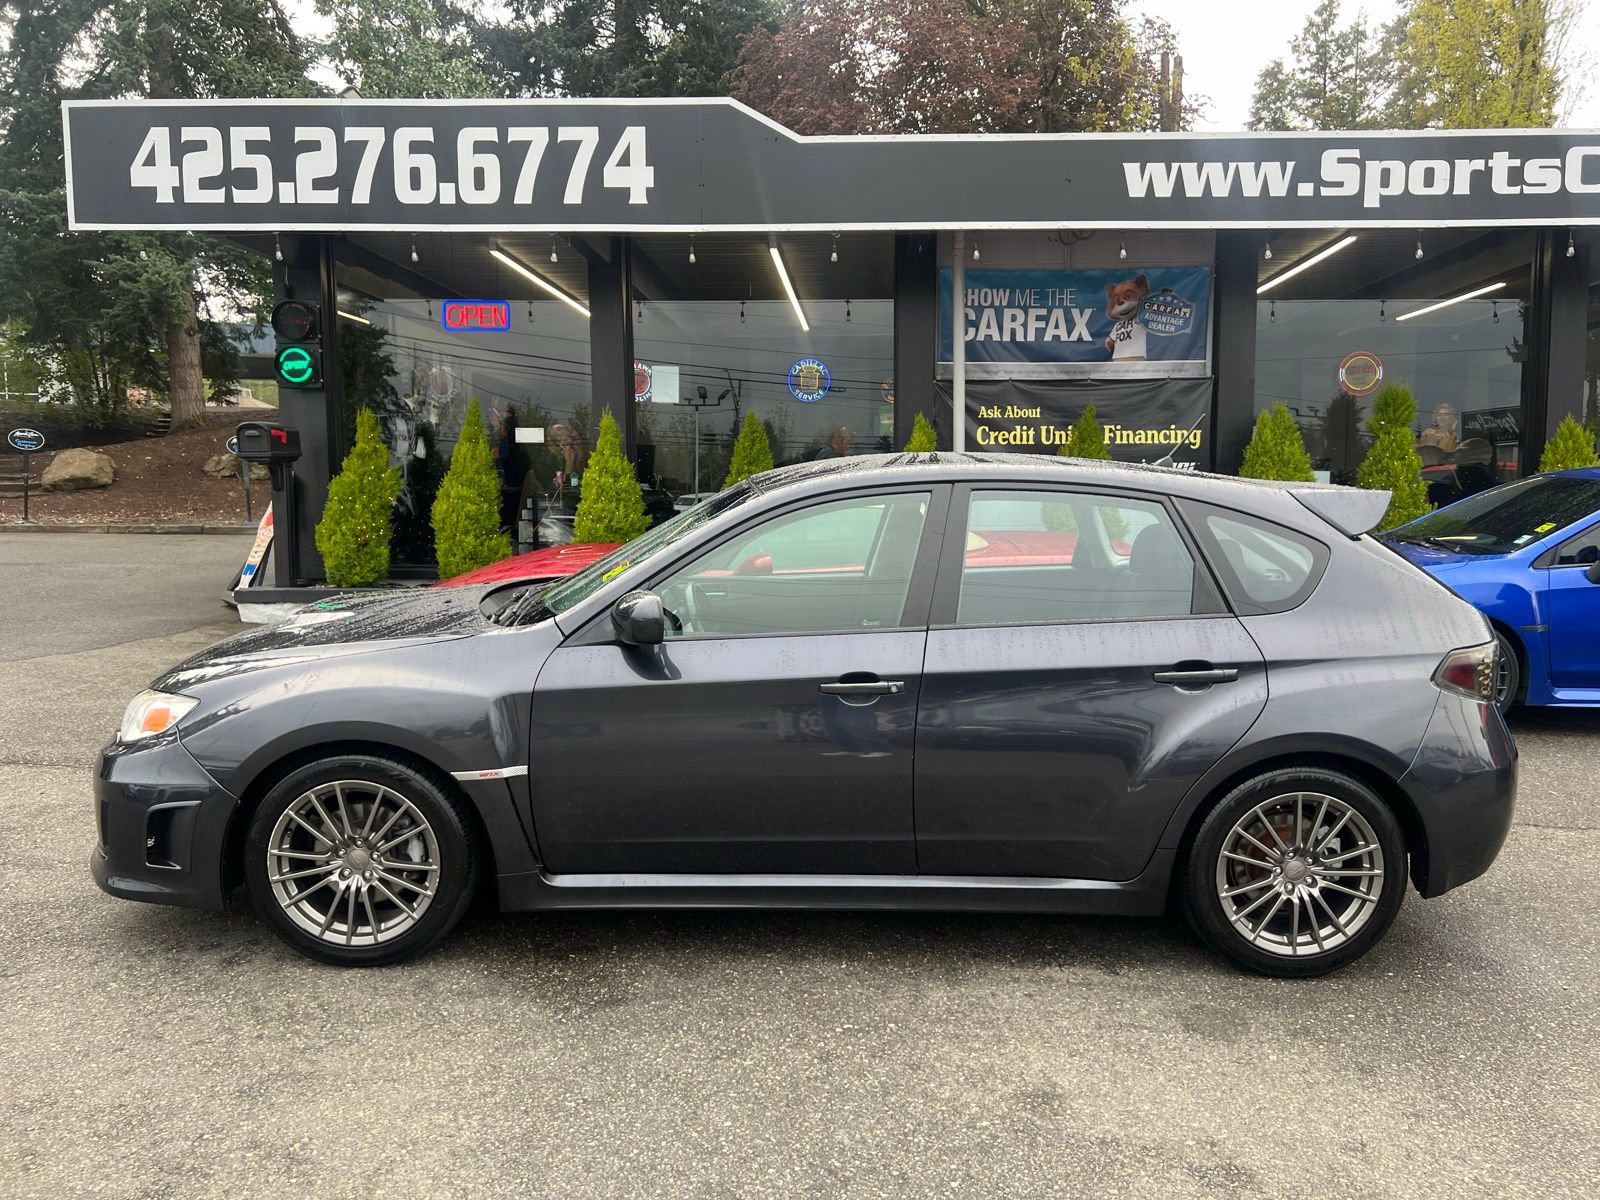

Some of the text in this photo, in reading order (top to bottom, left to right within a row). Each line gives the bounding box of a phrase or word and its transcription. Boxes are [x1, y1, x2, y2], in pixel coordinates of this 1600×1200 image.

[130, 126, 655, 206] 425.276.6774
[964, 288, 1077, 307] HOW ME THE
[446, 304, 507, 328] OPEN
[1143, 301, 1191, 318] CARFAX
[1144, 312, 1185, 326] ADVANTAGE
[1148, 322, 1176, 333] DEALER
[1115, 329, 1133, 342] FOX
[282, 360, 309, 370] OPEN
[792, 358, 828, 376] CADILLAC
[795, 388, 825, 401] SERVICE
[978, 405, 1041, 418] Ask About
[976, 425, 1035, 446] Credit
[1103, 425, 1202, 449] Financing
